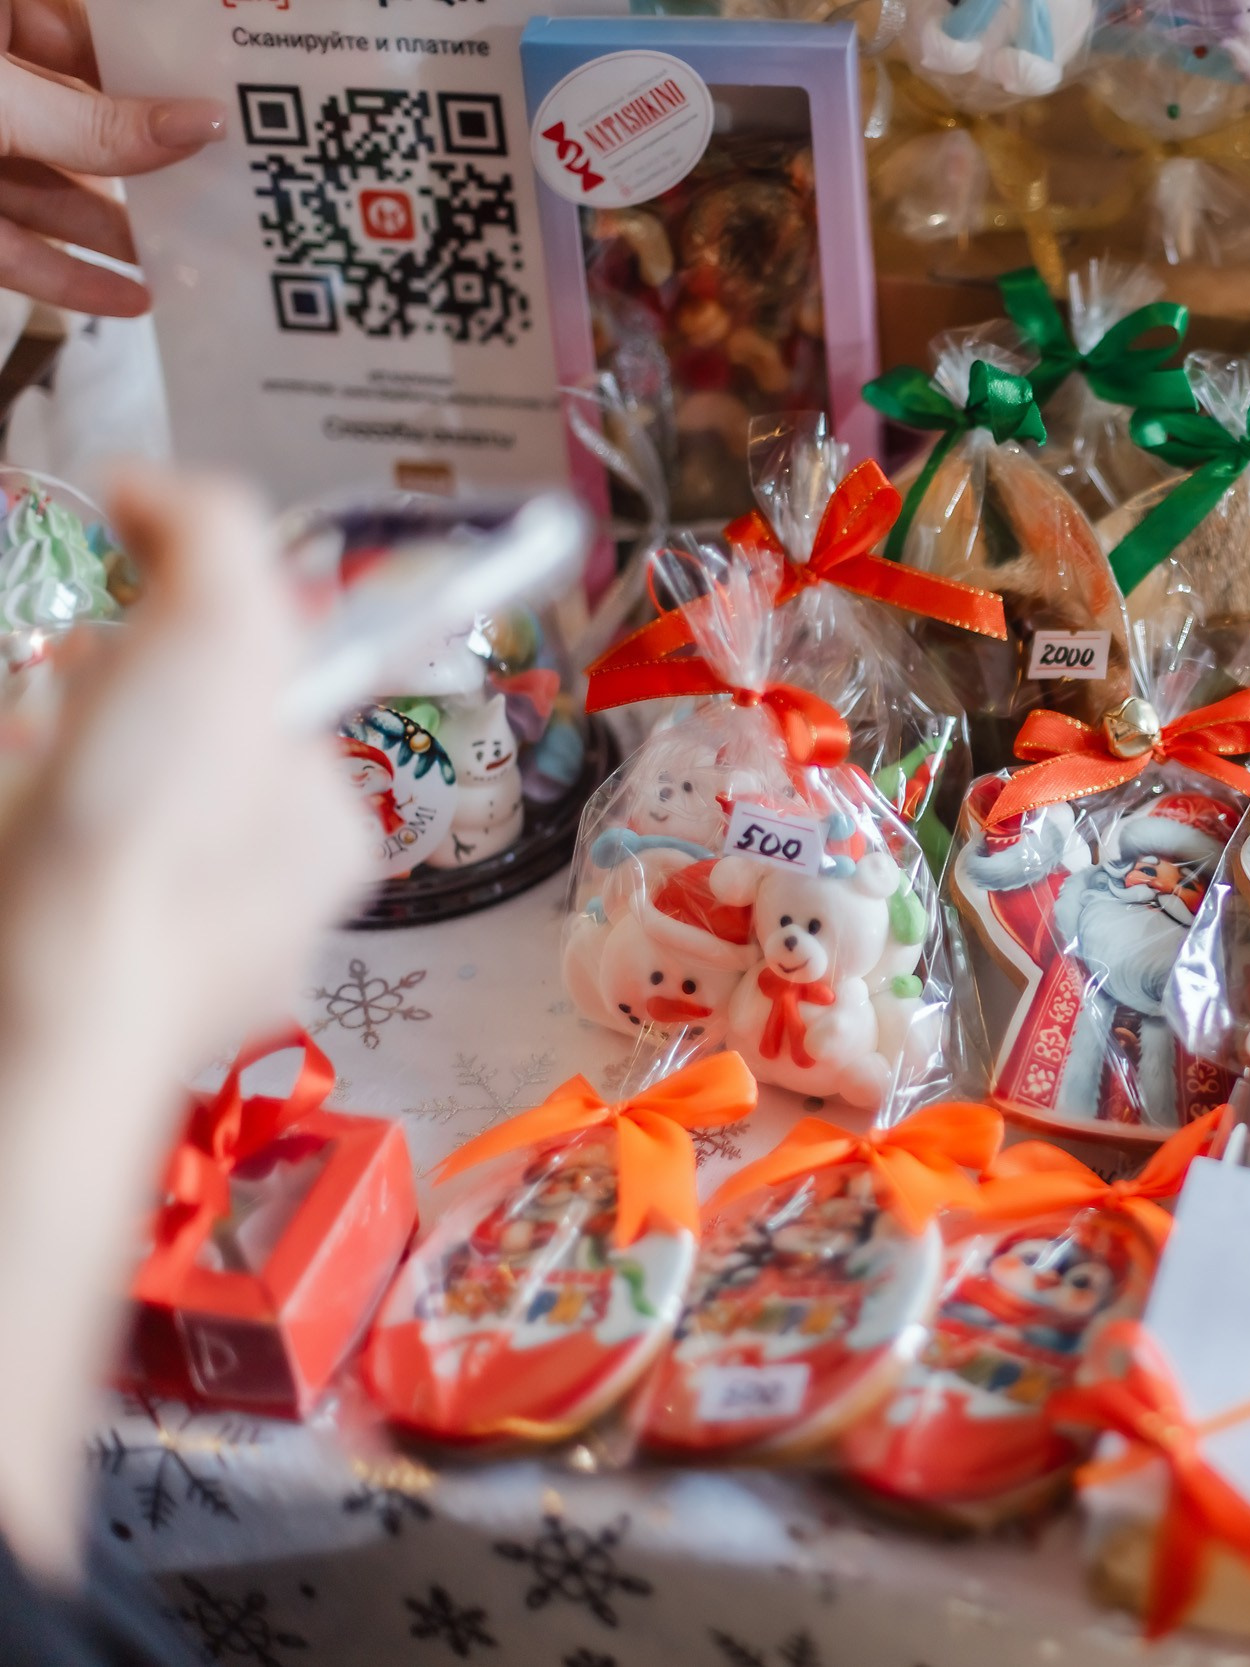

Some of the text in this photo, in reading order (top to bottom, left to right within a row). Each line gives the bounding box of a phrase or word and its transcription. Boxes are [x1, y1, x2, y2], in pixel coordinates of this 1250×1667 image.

[232, 26, 491, 58] Сканируйте и платите
[1040, 643, 1095, 668] 2000
[737, 823, 803, 861] 500
